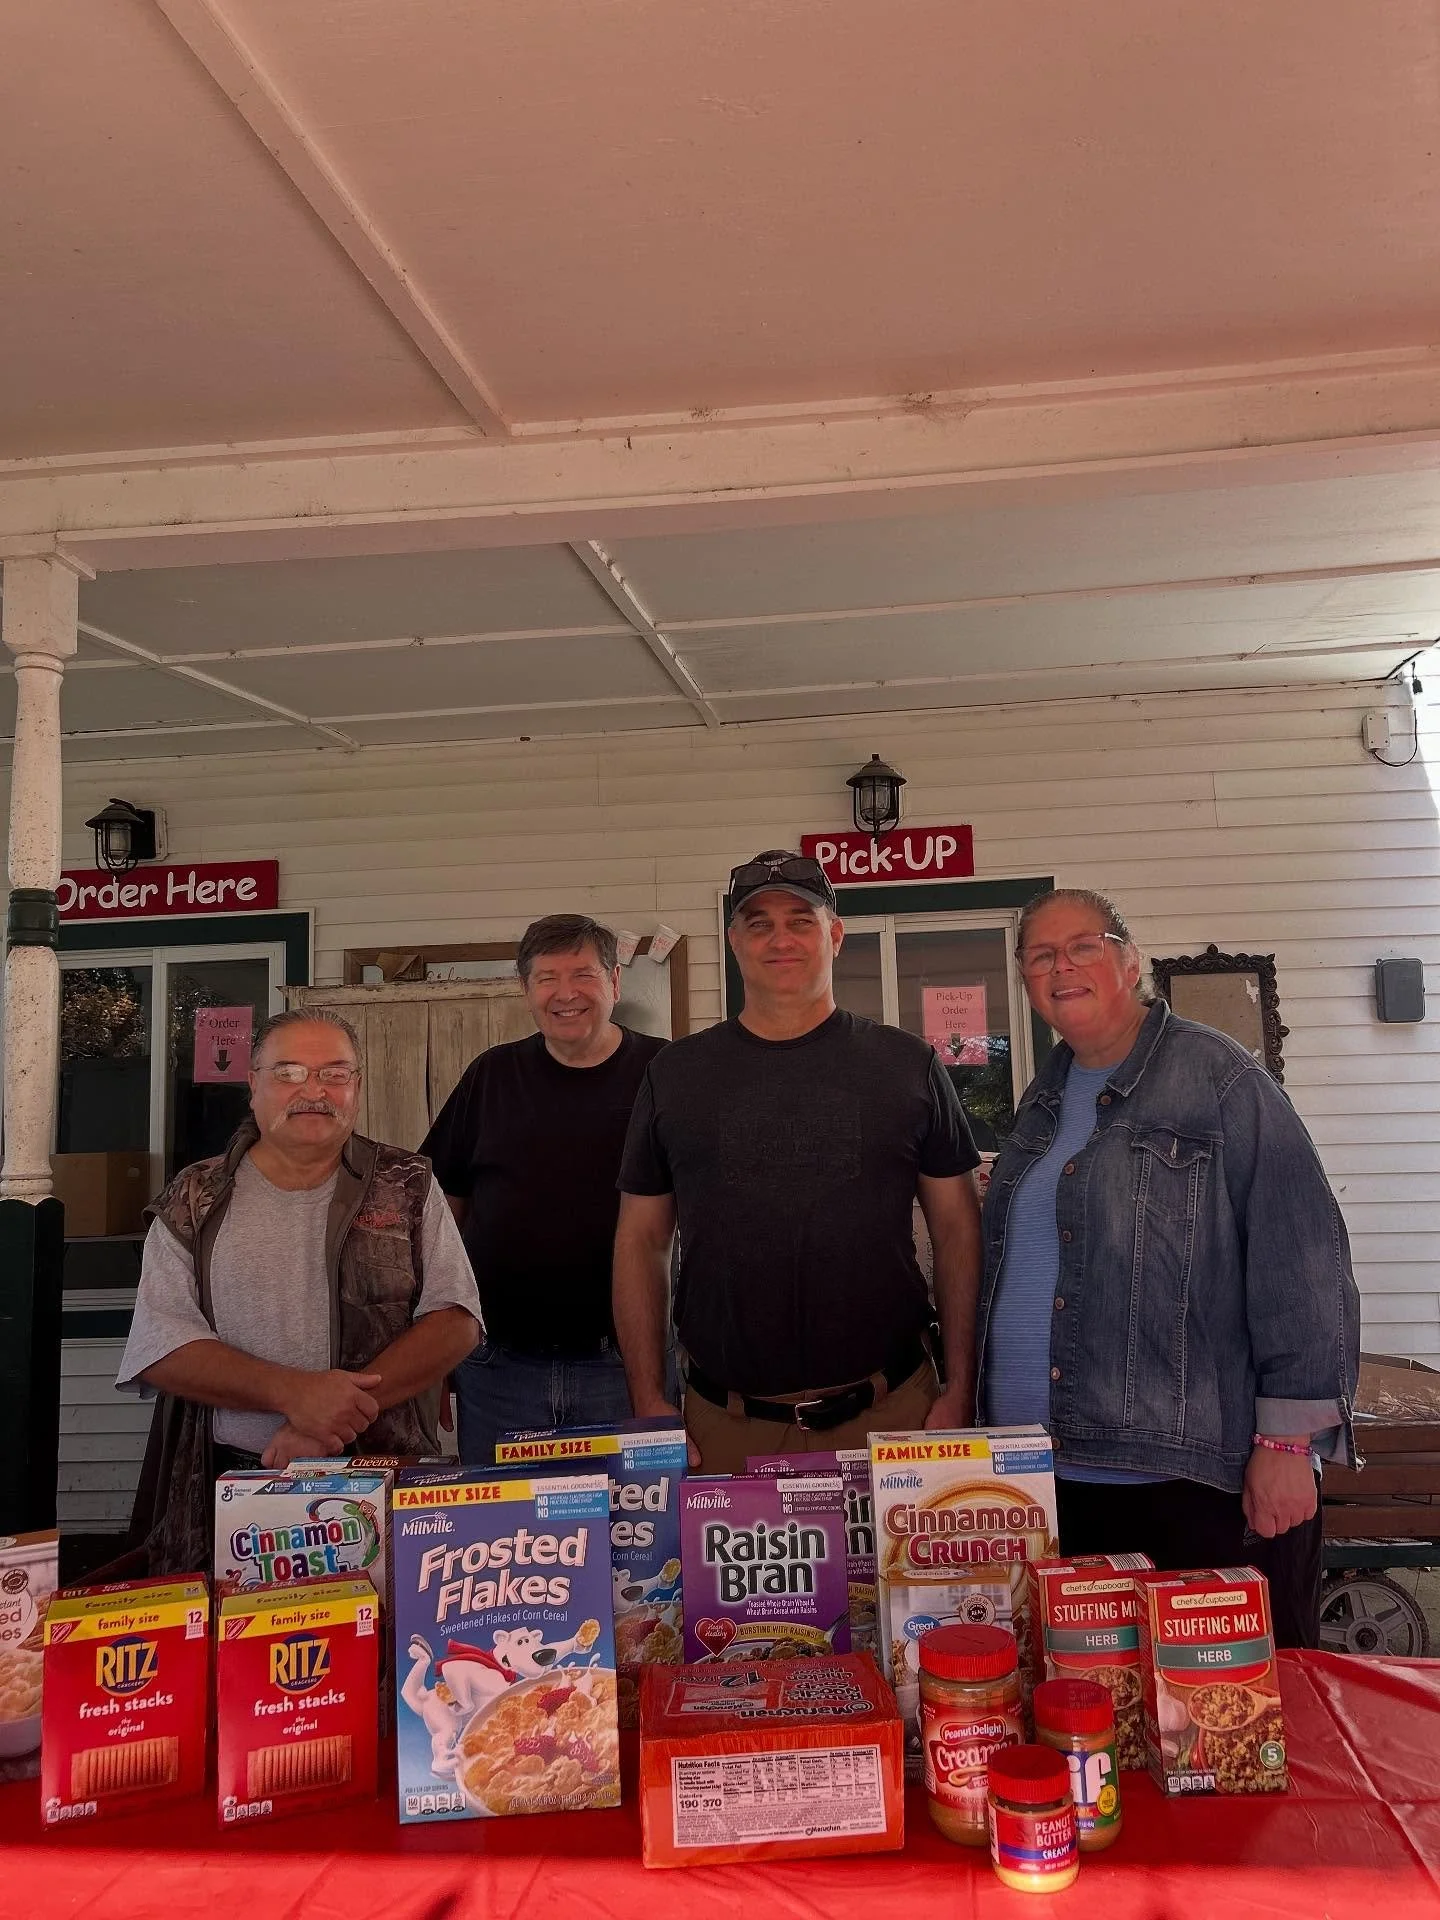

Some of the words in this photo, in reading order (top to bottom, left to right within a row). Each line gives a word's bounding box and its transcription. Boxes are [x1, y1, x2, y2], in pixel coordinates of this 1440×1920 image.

[815, 835, 957, 875] Pick-UP
[57, 876, 158, 912] Order
[166, 870, 257, 906] Here
[936, 992, 973, 1001] Pick-Up
[942, 1006, 968, 1015] Order
[210, 1018, 240, 1028] Order
[945, 1021, 966, 1029] Here
[501, 1443, 557, 1460] FAMILY
[560, 1440, 592, 1455] SIZE
[624, 1449, 634, 1459] NO
[877, 1446, 937, 1461] FAMILY
[938, 1444, 971, 1458] SIZE
[351, 1457, 400, 1467] Cheerios
[624, 1459, 635, 1470] NO
[994, 1453, 1005, 1463] NO
[841, 1461, 851, 1471] NO
[995, 1463, 1005, 1473] NO
[842, 1472, 852, 1481] NO
[880, 1476, 923, 1489] Millville
[399, 1489, 462, 1505] FAMILY
[465, 1486, 500, 1501] SIZE
[537, 1495, 549, 1506] NO
[687, 1495, 732, 1510] Millville
[782, 1493, 793, 1502] NO
[537, 1507, 549, 1518] NO
[783, 1504, 793, 1514] NO
[886, 1503, 1047, 1535] Cinnamon
[401, 1519, 453, 1536] Millville
[236, 1518, 360, 1557] Cinnamon
[705, 1522, 826, 1563] Raisin
[417, 1528, 588, 1592] Frosted
[630, 1550, 653, 1561] Cereal
[259, 1545, 339, 1584] Toast
[720, 1561, 814, 1602] Bran
[1093, 1581, 1131, 1593] cupboard
[436, 1569, 570, 1622] Flakes
[1205, 1594, 1243, 1606] cupboard
[188, 1611, 202, 1624] 12
[271, 1611, 307, 1626] family
[310, 1609, 331, 1621] size
[358, 1607, 372, 1620] 12
[773, 1607, 789, 1615] Cereal
[1054, 1602, 1118, 1623] STUFFING
[1121, 1601, 1137, 1618] MI
[98, 1614, 134, 1630] family
[138, 1612, 160, 1624] size
[440, 1615, 484, 1636] Sweetened
[486, 1611, 511, 1625] Flakes
[512, 1610, 521, 1621] of
[523, 1610, 541, 1620] Corn
[543, 1610, 568, 1621] Cereal
[907, 1621, 935, 1631] Great
[1164, 1616, 1230, 1638] STUFFING
[1234, 1613, 1260, 1633] MIX
[740, 1625, 771, 1636] BURSTING
[773, 1625, 788, 1634] WITH
[790, 1625, 818, 1639] RAISINS!
[1086, 1634, 1119, 1647] HERB
[96, 1641, 158, 1687] RITZ
[270, 1638, 331, 1685] RITZ
[1197, 1650, 1232, 1663] HERB
[720, 1671, 766, 1688] 12
[786, 1672, 853, 1681] Chicken
[79, 1698, 120, 1720] fresh
[124, 1690, 174, 1712] stacks
[254, 1696, 294, 1717] fresh
[298, 1688, 346, 1709] stacks
[740, 1706, 852, 1719] Maruchan
[108, 1720, 144, 1737] original
[282, 1719, 318, 1735] original
[944, 1727, 972, 1740] Peanut
[972, 1723, 1002, 1736] Delight
[936, 1741, 1012, 1771] Cream
[1267, 1748, 1278, 1758] 5
[1066, 1751, 1112, 1804] if
[680, 1800, 699, 1809] 190
[703, 1799, 722, 1808] 370
[812, 1825, 841, 1833] Maruchan
[1035, 1815, 1071, 1834] PEANUT
[1036, 1828, 1072, 1847] BUTTER
[1042, 1844, 1070, 1859] CREAMY
